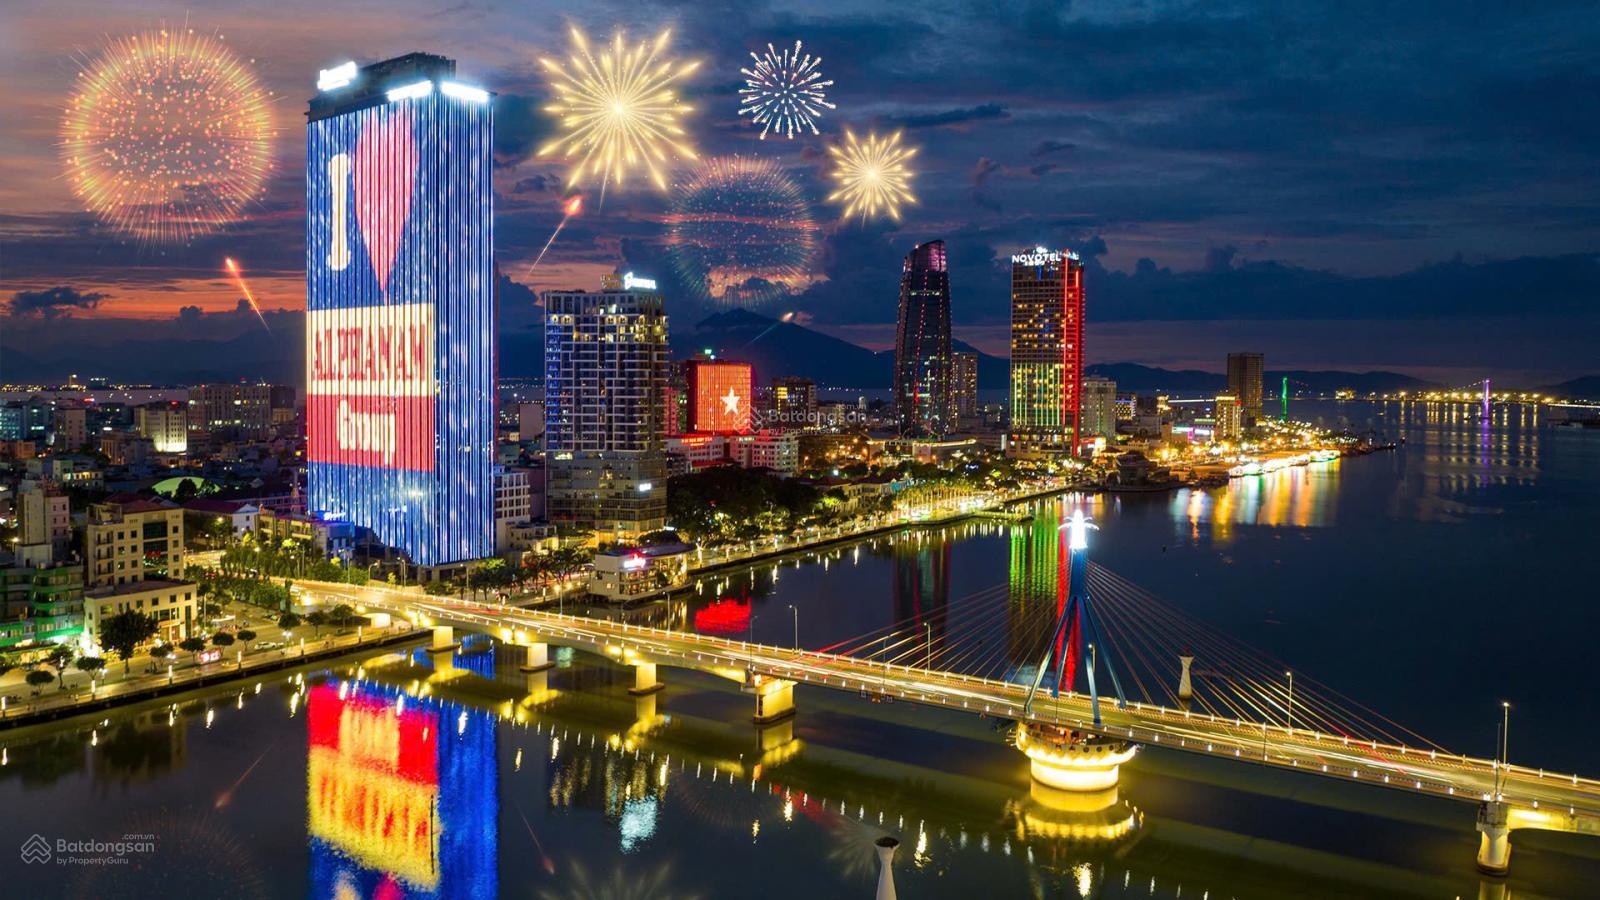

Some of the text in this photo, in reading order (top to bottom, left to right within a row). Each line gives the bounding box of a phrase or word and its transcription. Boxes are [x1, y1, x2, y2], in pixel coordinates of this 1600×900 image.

[328, 153, 351, 271] I
[1012, 253, 1061, 263] NOVOTEL
[312, 324, 426, 382] ALPHANAM
[336, 399, 396, 465] Group
